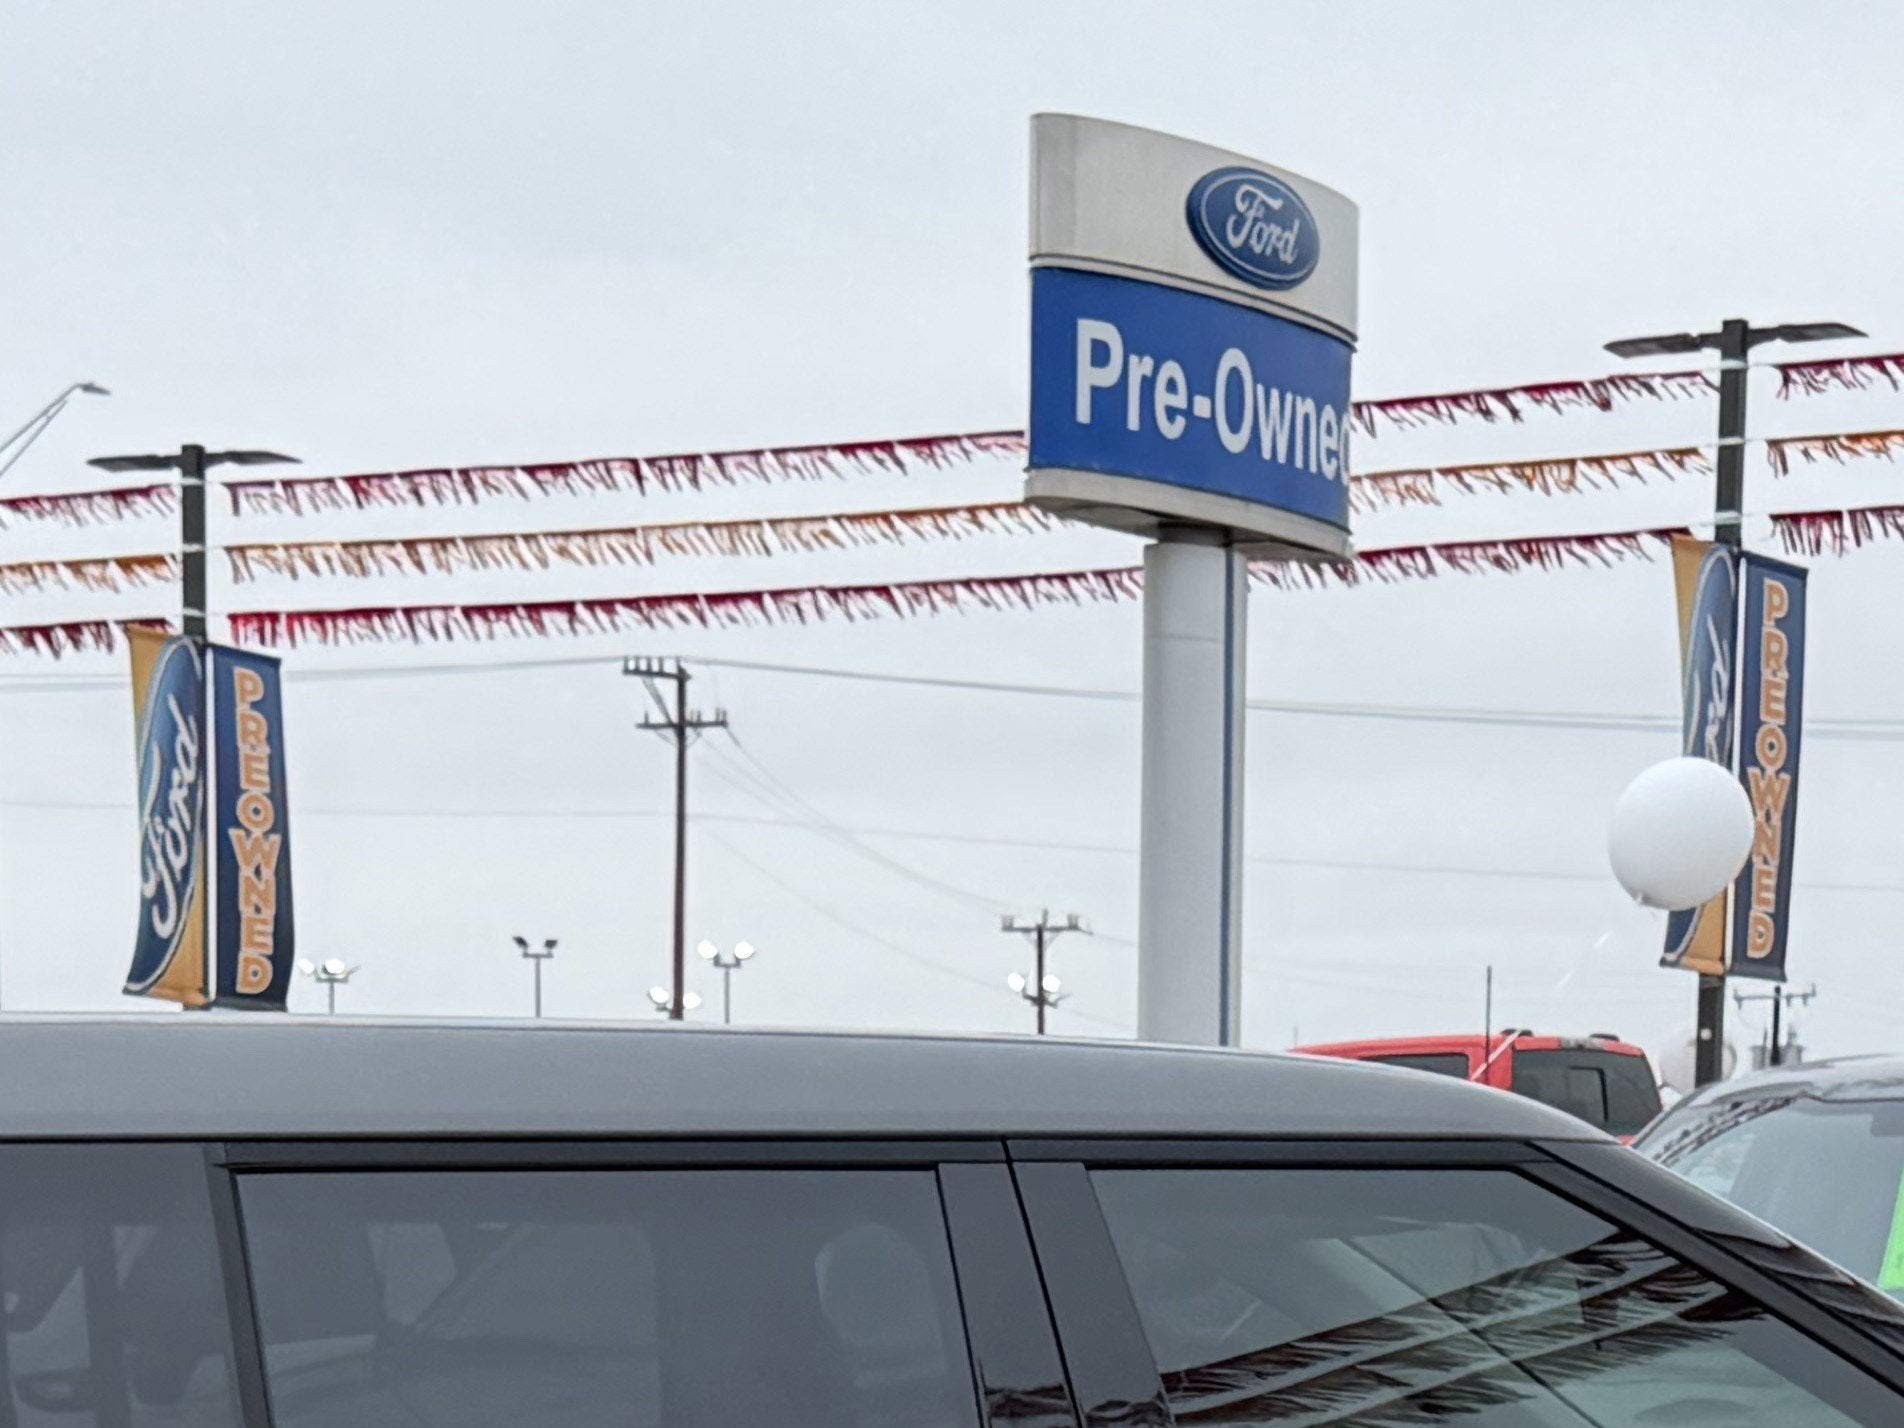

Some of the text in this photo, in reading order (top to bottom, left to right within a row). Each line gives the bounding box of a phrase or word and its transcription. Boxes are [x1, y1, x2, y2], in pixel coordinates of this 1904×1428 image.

[1226, 183, 1301, 266] Ford
[142, 693, 200, 940] Ford
[228, 666, 282, 995] PREOWNED
[1747, 578, 1791, 959] PREOWNED
